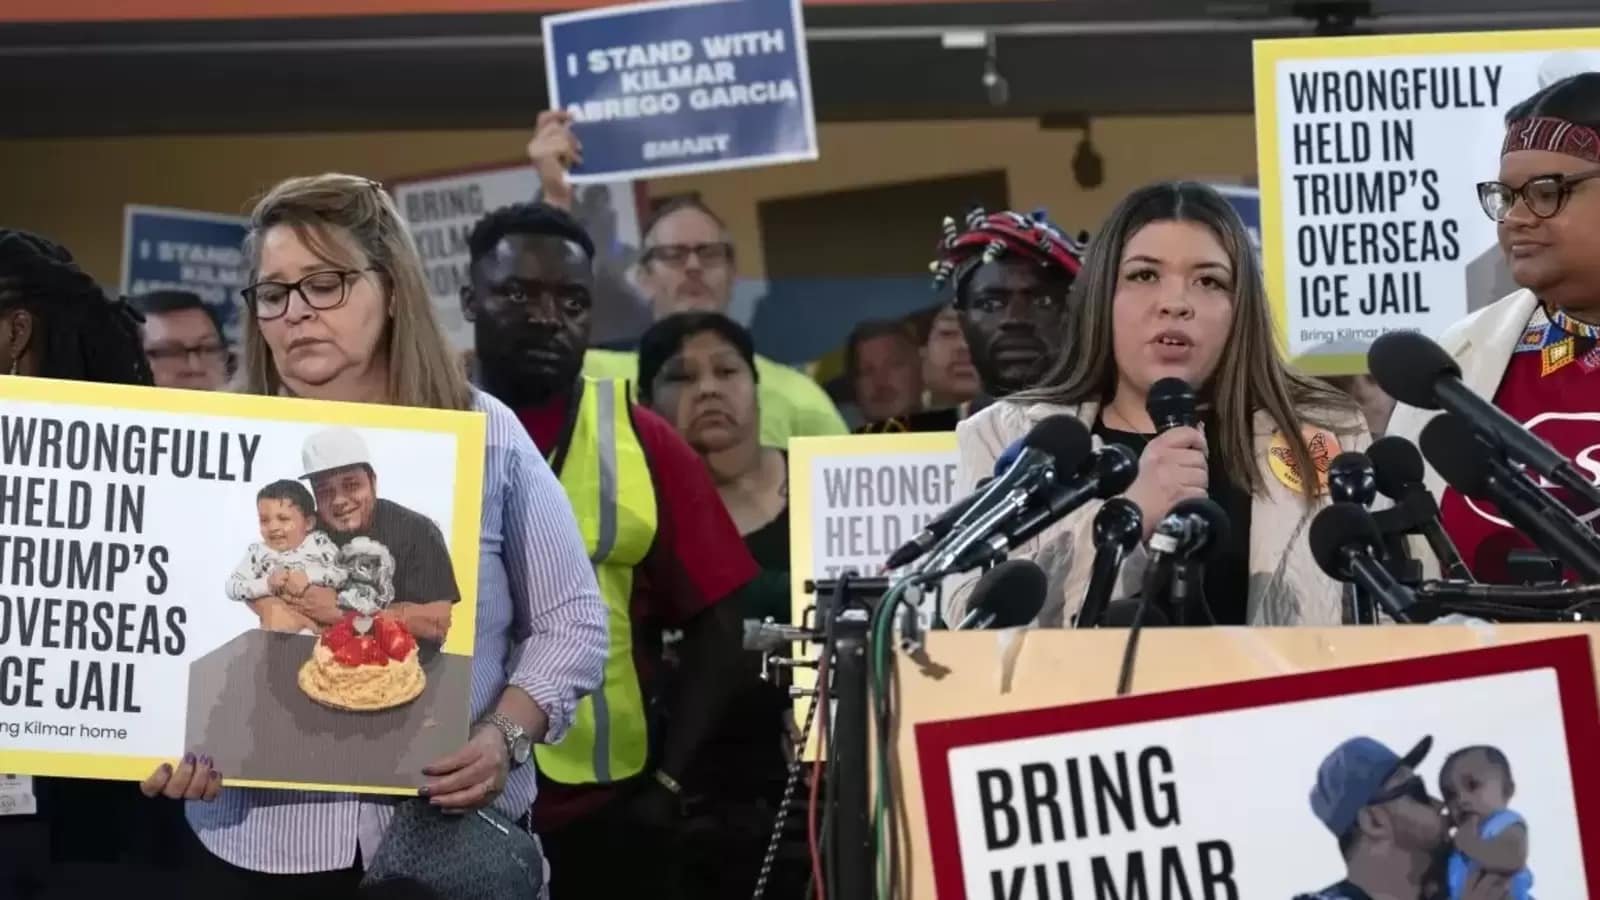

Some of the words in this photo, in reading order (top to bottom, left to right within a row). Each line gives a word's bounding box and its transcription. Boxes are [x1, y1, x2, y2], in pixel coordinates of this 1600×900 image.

[567, 53, 578, 76] I
[587, 40, 693, 73] STAND
[703, 29, 785, 59] WITH
[621, 61, 736, 93] KILMAR
[1290, 65, 1503, 115] WRONGFULLY
[567, 92, 681, 123] ABREGO
[690, 79, 797, 110] GARCIA
[643, 134, 730, 160] SMART
[1293, 121, 1370, 165] HELD
[1383, 119, 1415, 162] IN
[405, 184, 483, 223] BRING
[1293, 169, 1441, 217] TRUMP’S
[1298, 219, 1461, 267] OVERSEAS
[1300, 275, 1349, 318] ICE
[1359, 271, 1430, 315] JAIL
[1300, 329, 1334, 345] Bring
[1336, 327, 1378, 339] Kilmar
[1, 414, 261, 483] WRONGFULLY
[0, 475, 92, 531] HELD
[104, 482, 146, 534] IN
[823, 464, 958, 509] WRONGF
[825, 515, 901, 558] HELD
[0, 596, 188, 657] OVERSEAS
[0, 655, 46, 708] CE
[55, 660, 142, 713] JAIL
[24, 721, 77, 737] Kilmar
[80, 724, 128, 740] home
[977, 745, 1181, 852] BRING
